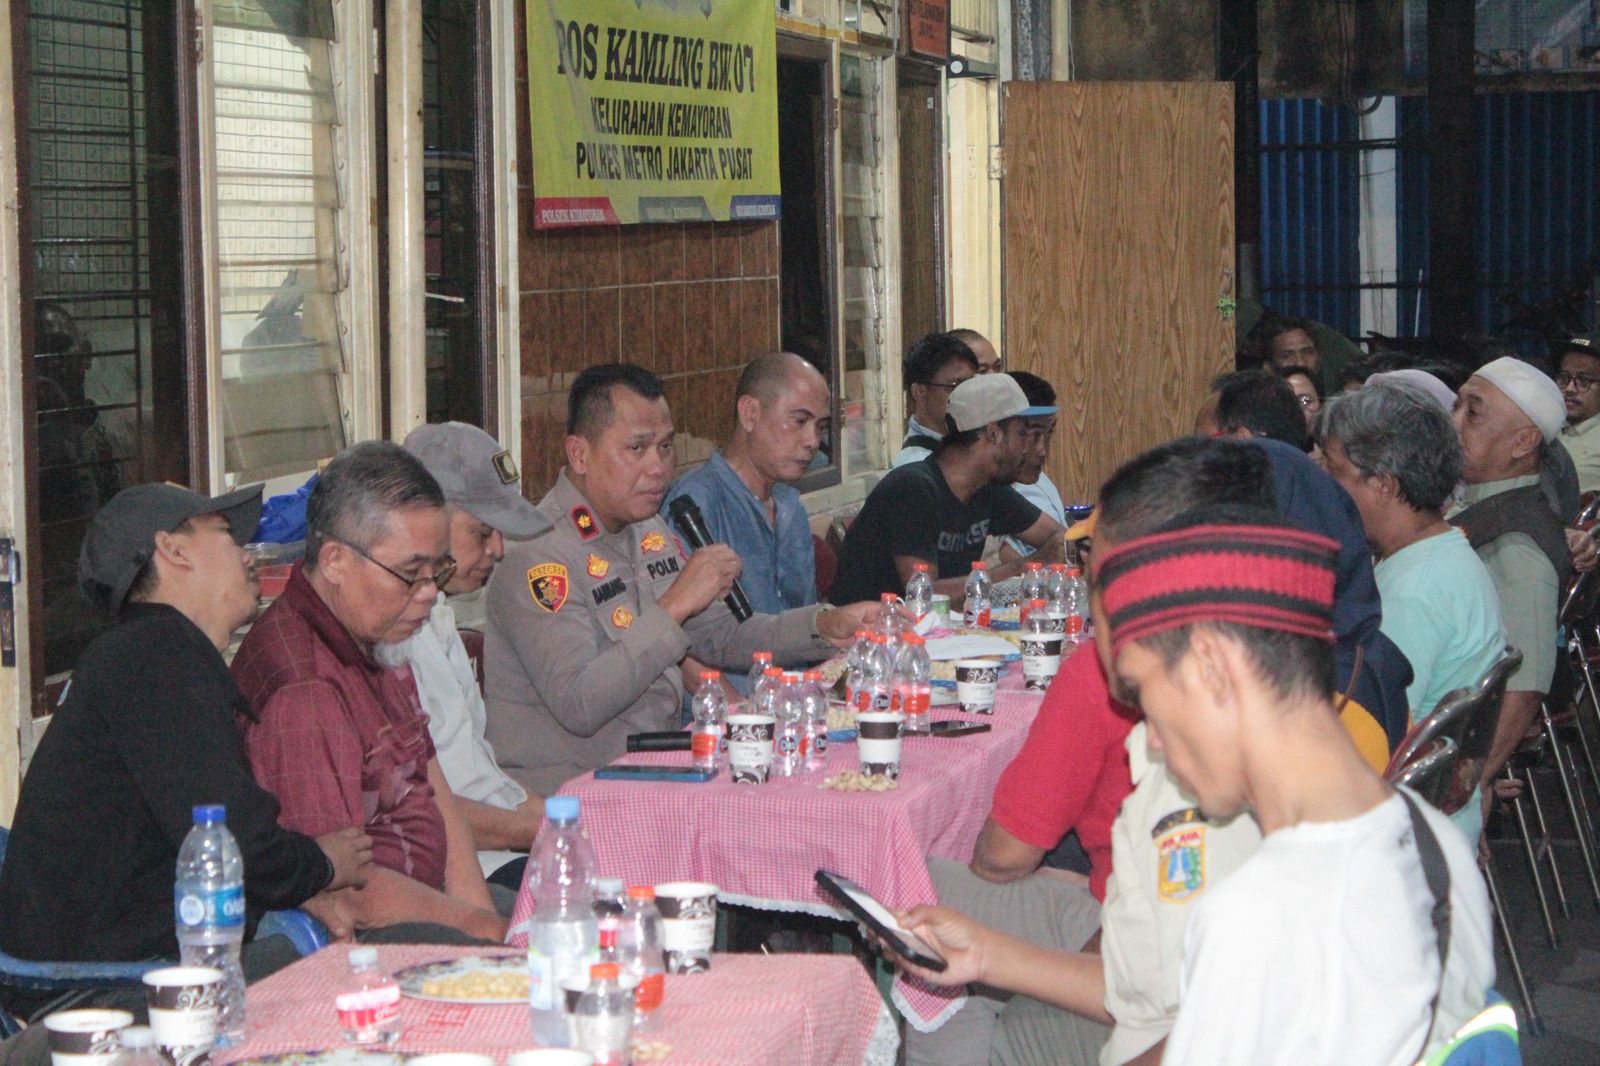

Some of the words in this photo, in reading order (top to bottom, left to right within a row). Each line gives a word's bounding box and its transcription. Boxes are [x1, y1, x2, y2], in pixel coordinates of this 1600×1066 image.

[604, 26, 705, 89] KAMLING
[590, 97, 665, 137] KELURAHAN
[667, 102, 733, 139] KEMAYORAN
[622, 145, 663, 181] METRO
[666, 146, 718, 181] JAKARTA
[718, 147, 753, 180] PUSAT
[647, 555, 680, 580] POLRI
